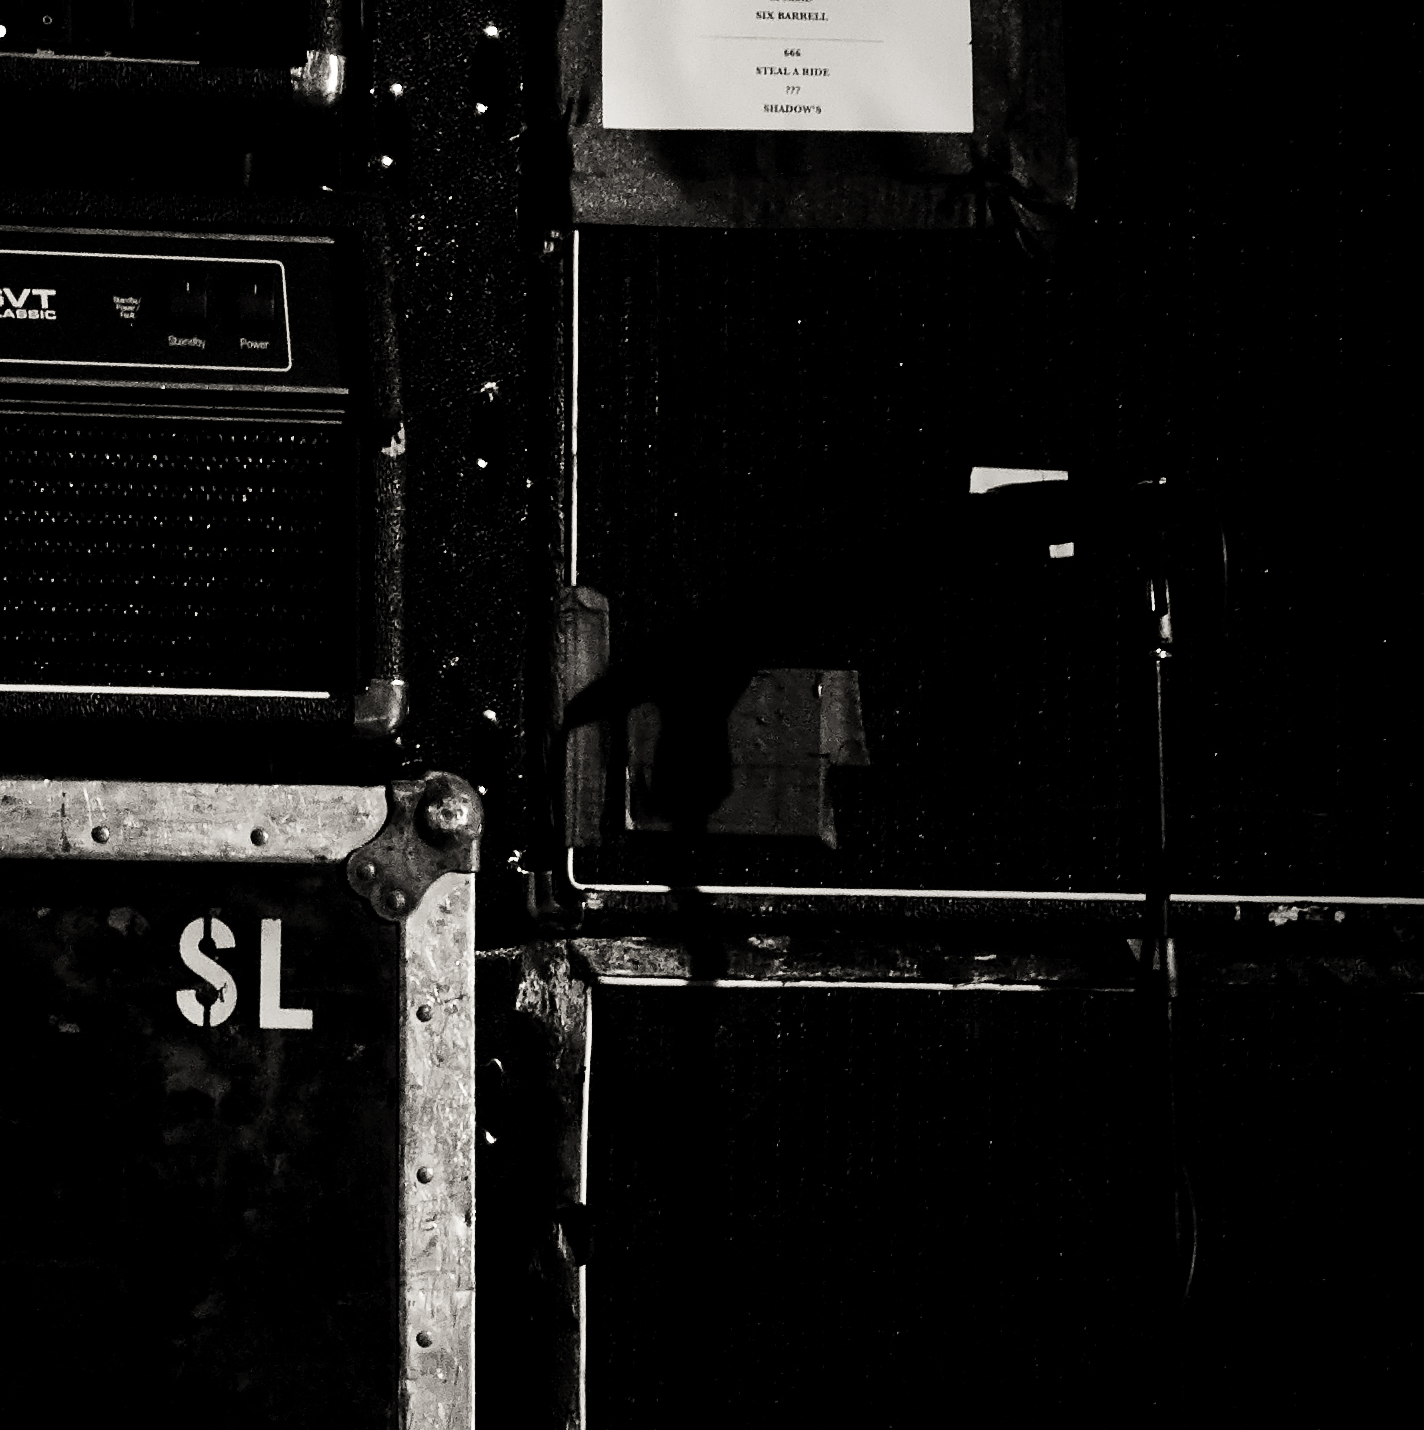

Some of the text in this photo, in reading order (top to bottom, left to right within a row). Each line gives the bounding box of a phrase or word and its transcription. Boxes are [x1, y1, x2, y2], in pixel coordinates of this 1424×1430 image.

[755, 10, 829, 22] SIX BARRELL
[783, 48, 801, 57] 666
[755, 66, 831, 77] STEAL A RIDE
[785, 85, 801, 95] ???
[763, 104, 822, 115] SHADOW'S
[167, 334, 207, 350] Standby
[239, 337, 270, 351] Power
[176, 917, 314, 1029] SL
